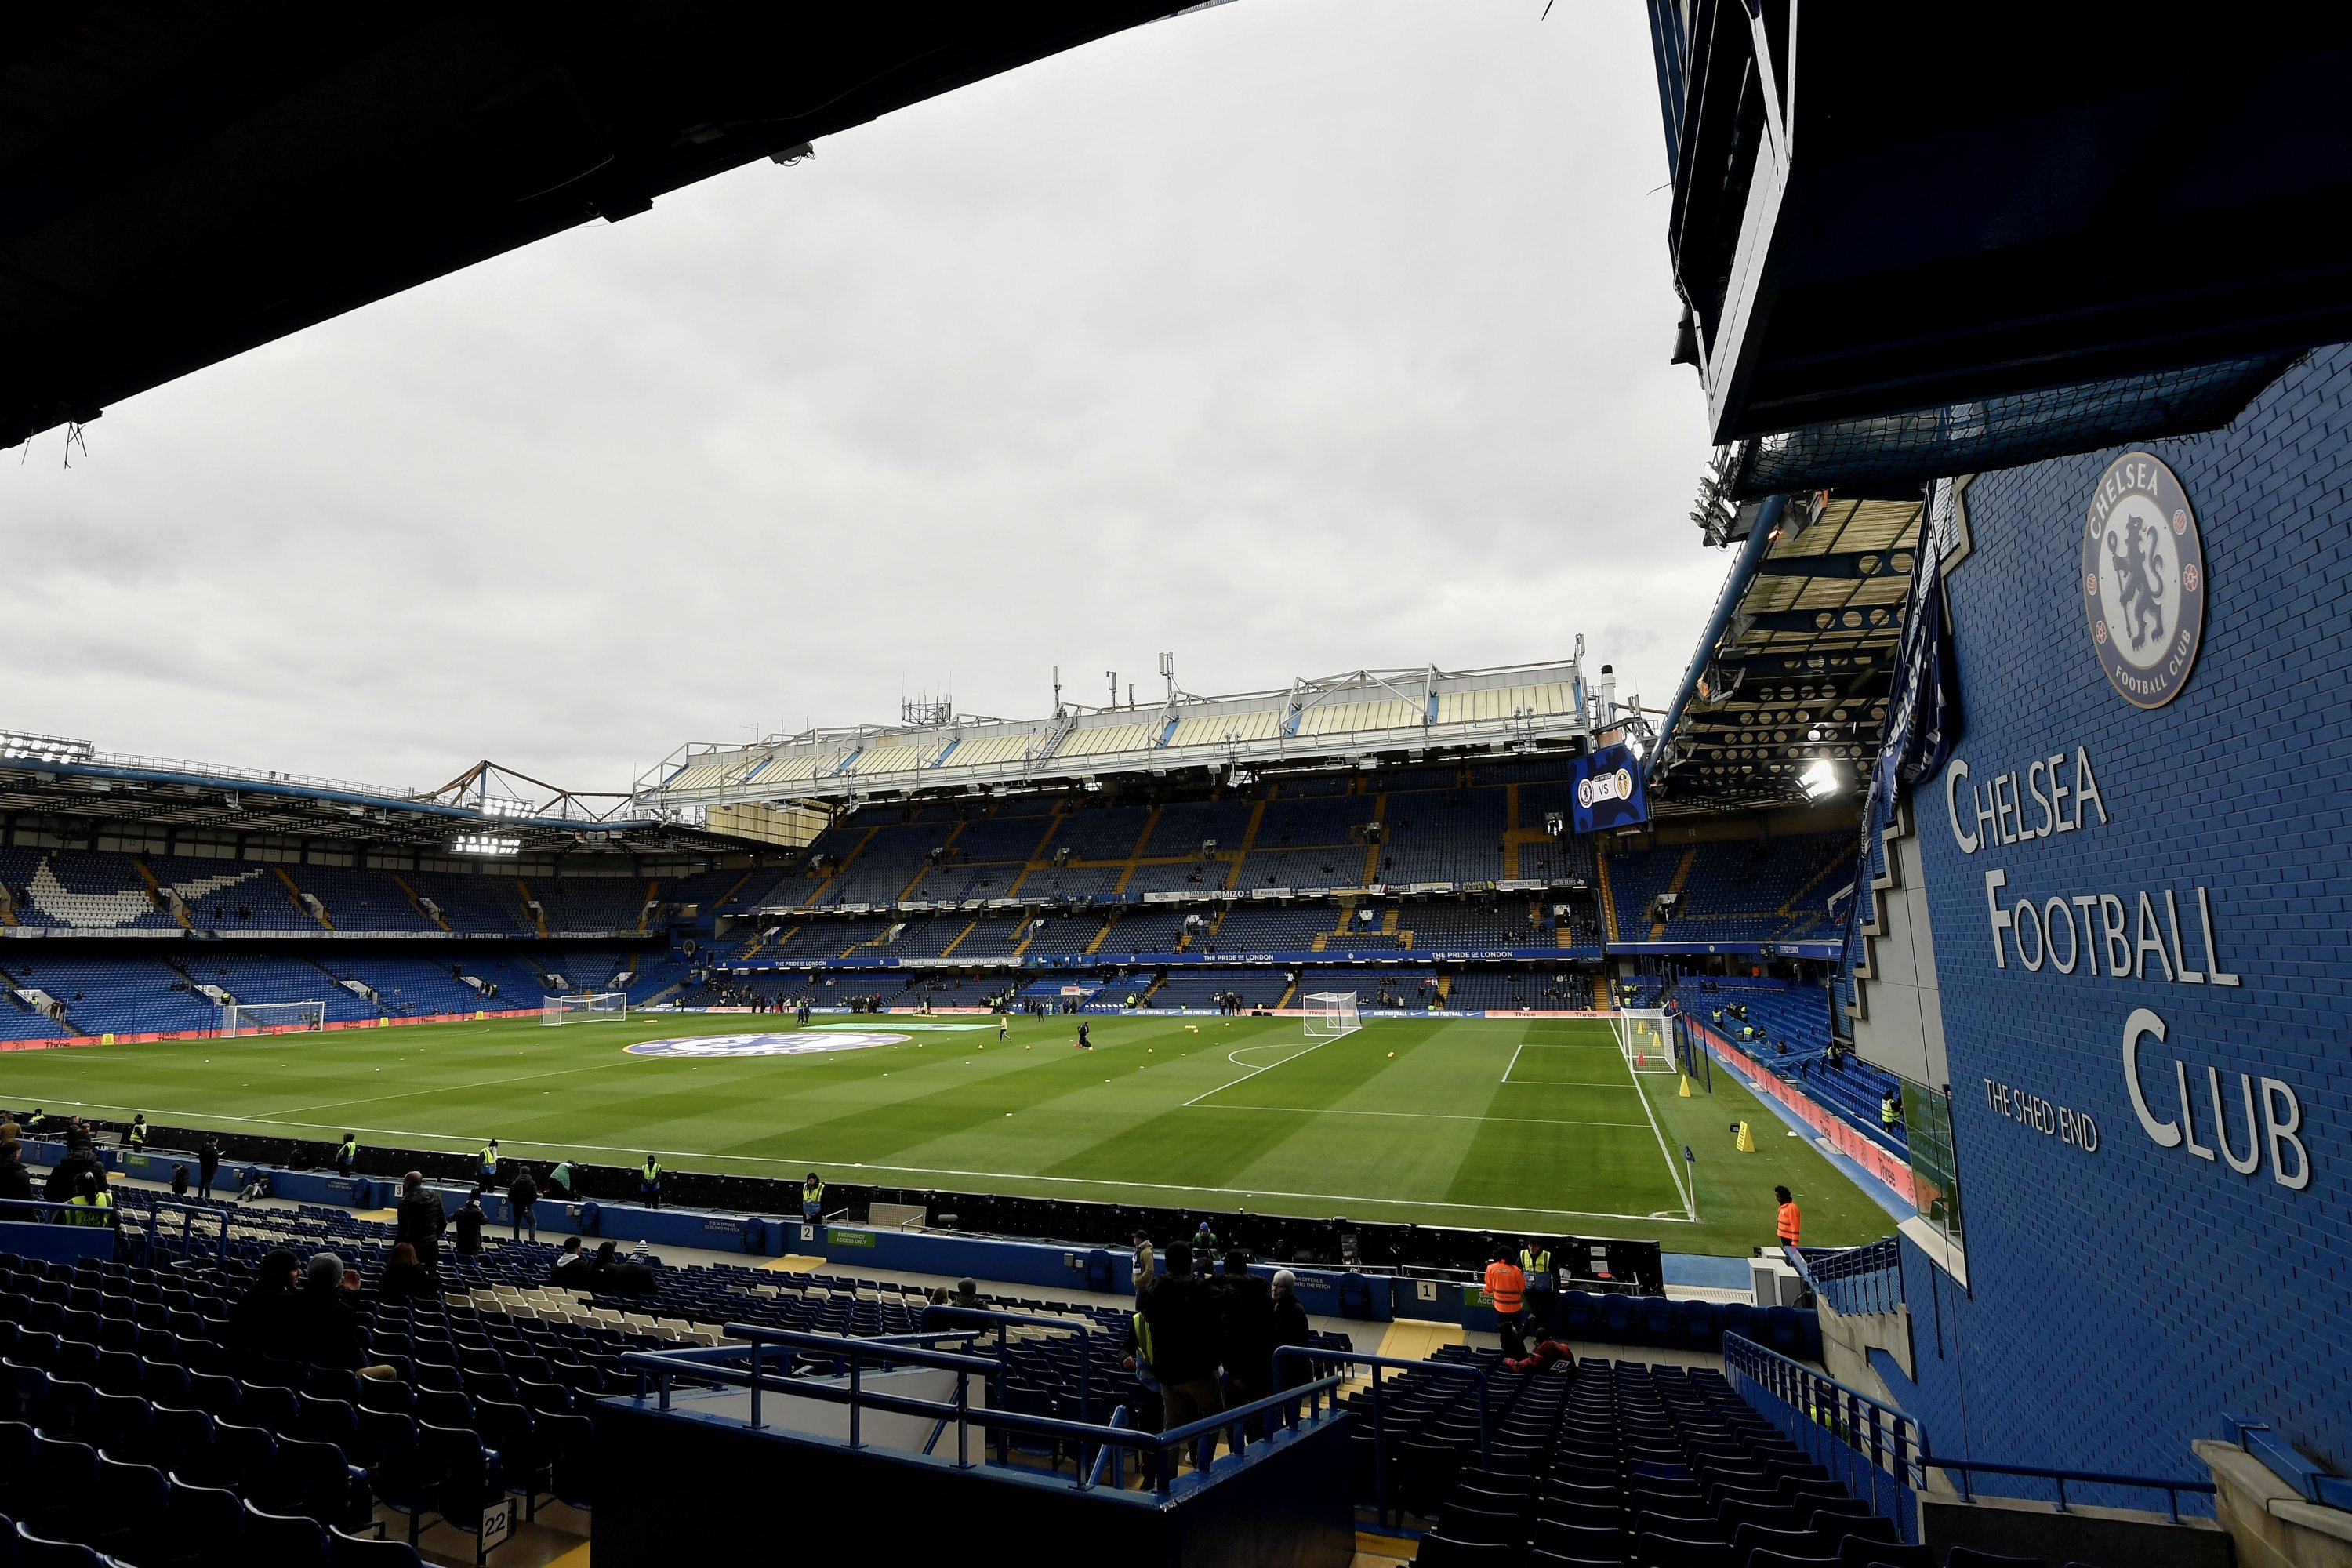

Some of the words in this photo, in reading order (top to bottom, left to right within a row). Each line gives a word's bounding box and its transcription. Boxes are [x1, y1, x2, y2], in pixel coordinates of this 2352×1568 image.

[2089, 463, 2159, 540] CHELSEA
[2114, 663, 2168, 695] FOOTBALL
[2169, 628, 2191, 677] CLUB
[1598, 783, 1609, 796] VS
[1946, 746, 2107, 855] CHELSEA
[64, 928, 73, 938] JT
[1985, 869, 2240, 987] FOOTBALL
[2122, 1007, 2310, 1190] CLUB
[1984, 1077, 2012, 1119] THE
[2013, 1088, 2056, 1136] SHED
[2059, 1106, 2099, 1153] END
[1878, 1157, 1896, 1187] Three
[396, 1186, 401, 1195] 3
[804, 1227, 811, 1238] 2
[1422, 1284, 1431, 1297] 1
[485, 1512, 506, 1538] 22
